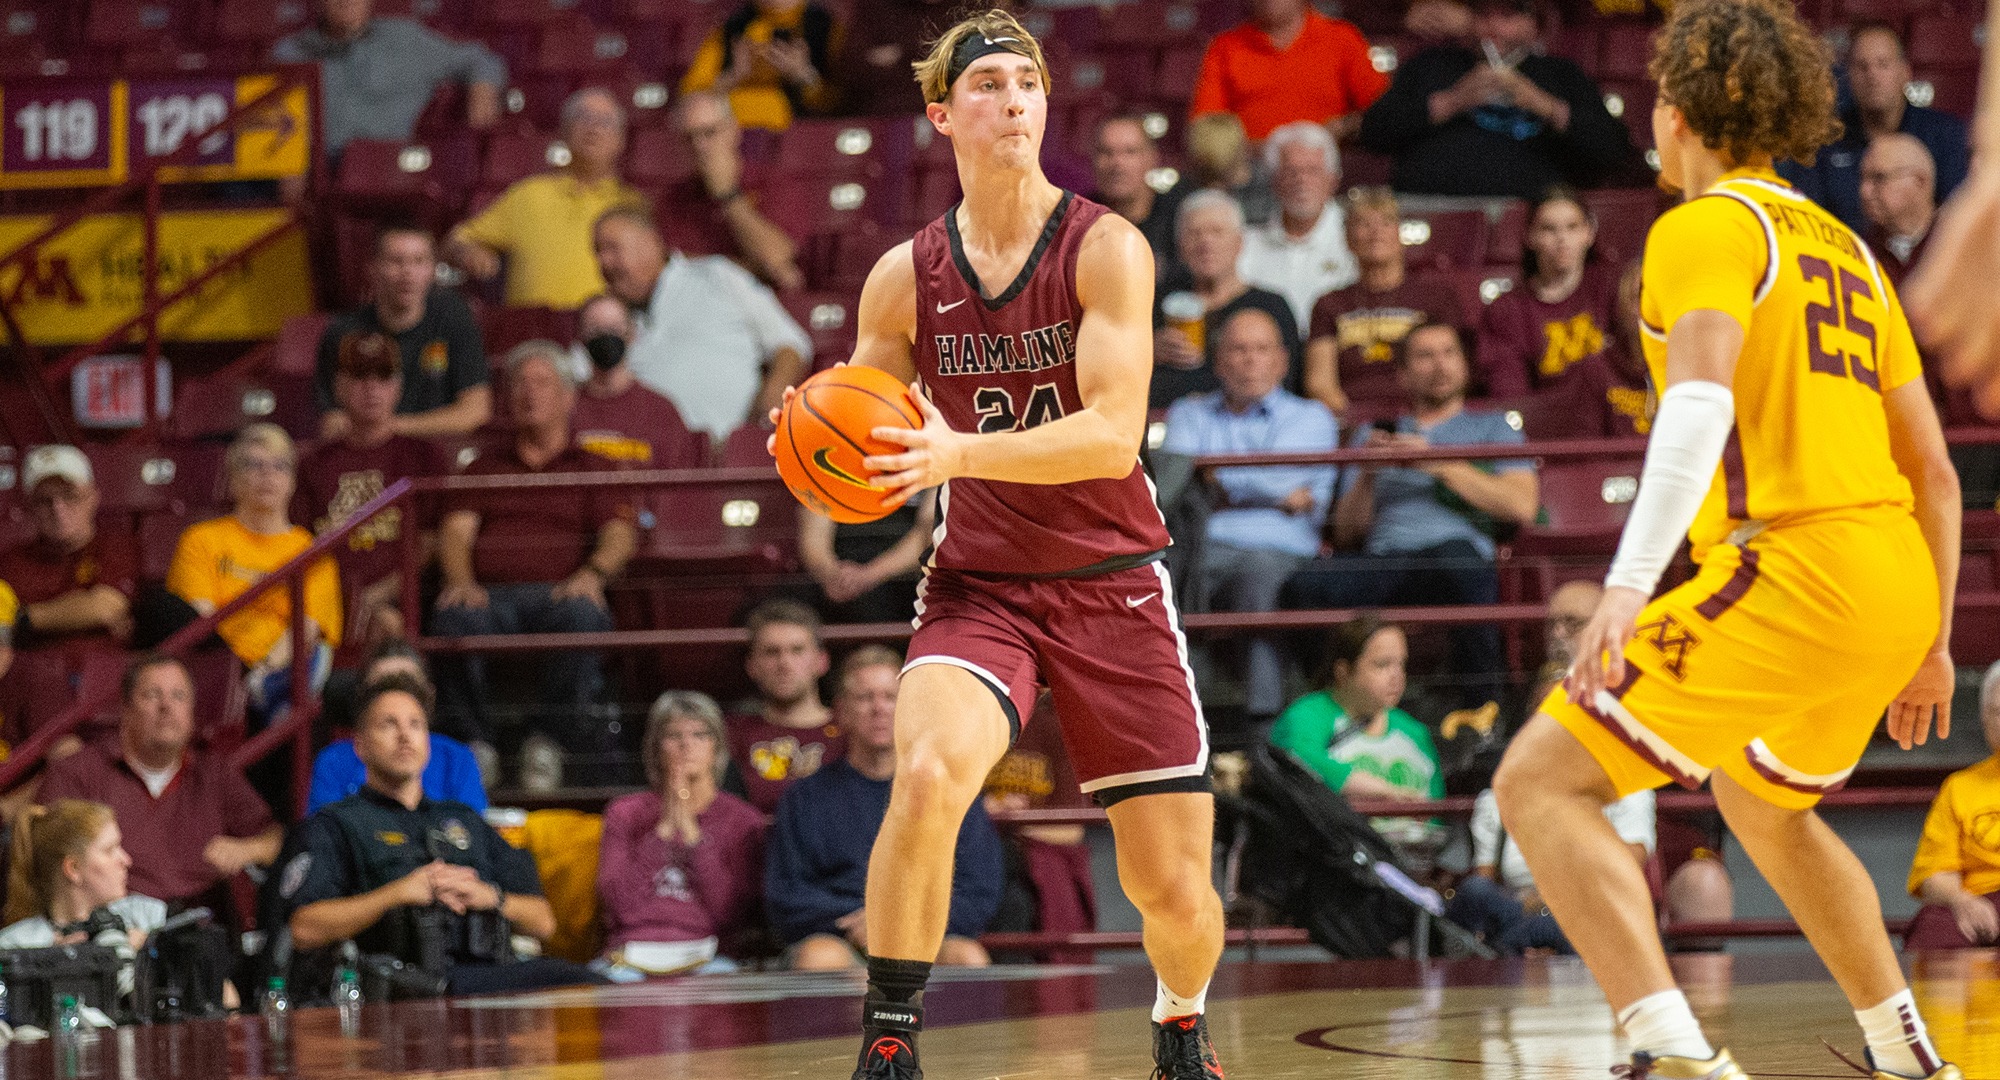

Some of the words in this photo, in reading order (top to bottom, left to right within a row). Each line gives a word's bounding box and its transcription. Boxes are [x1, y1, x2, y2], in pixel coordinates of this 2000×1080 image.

[14, 98, 99, 162] 119
[1763, 202, 1868, 266] PATTERSON
[934, 319, 1077, 376] HAMLINE
[1797, 253, 1883, 396] 25
[972, 381, 1067, 435] 24
